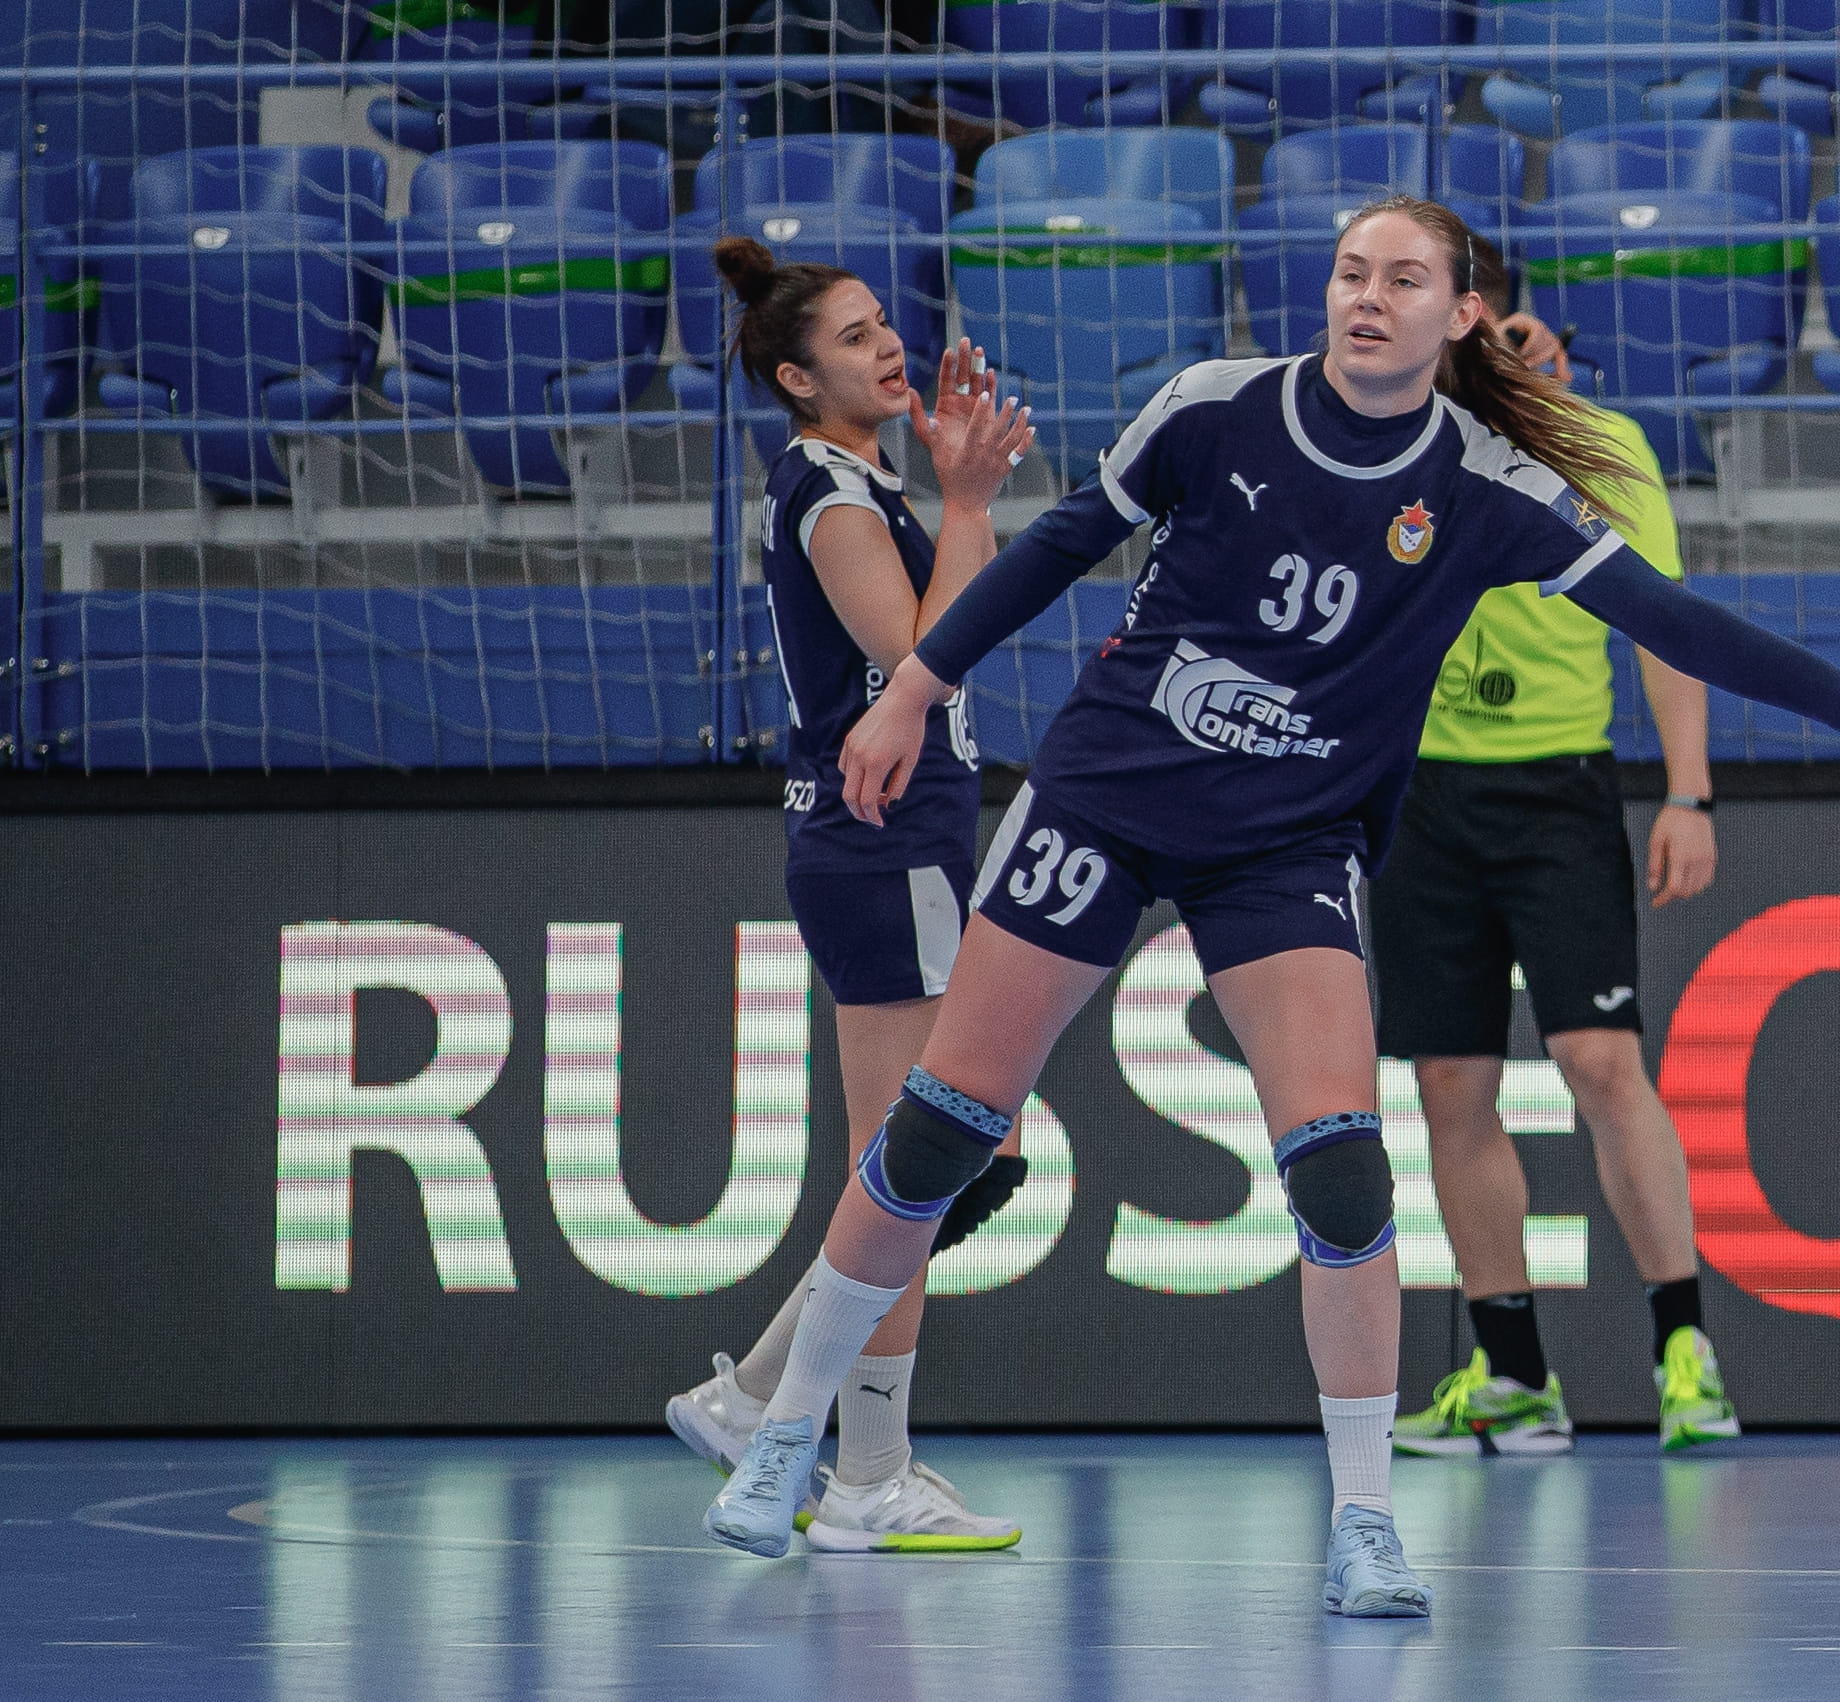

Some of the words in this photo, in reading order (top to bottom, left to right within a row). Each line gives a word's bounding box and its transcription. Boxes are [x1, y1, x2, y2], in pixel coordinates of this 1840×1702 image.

[1259, 553, 1358, 645] 39
[1207, 681, 1313, 736] Trans
[1008, 828, 1107, 926] 39
